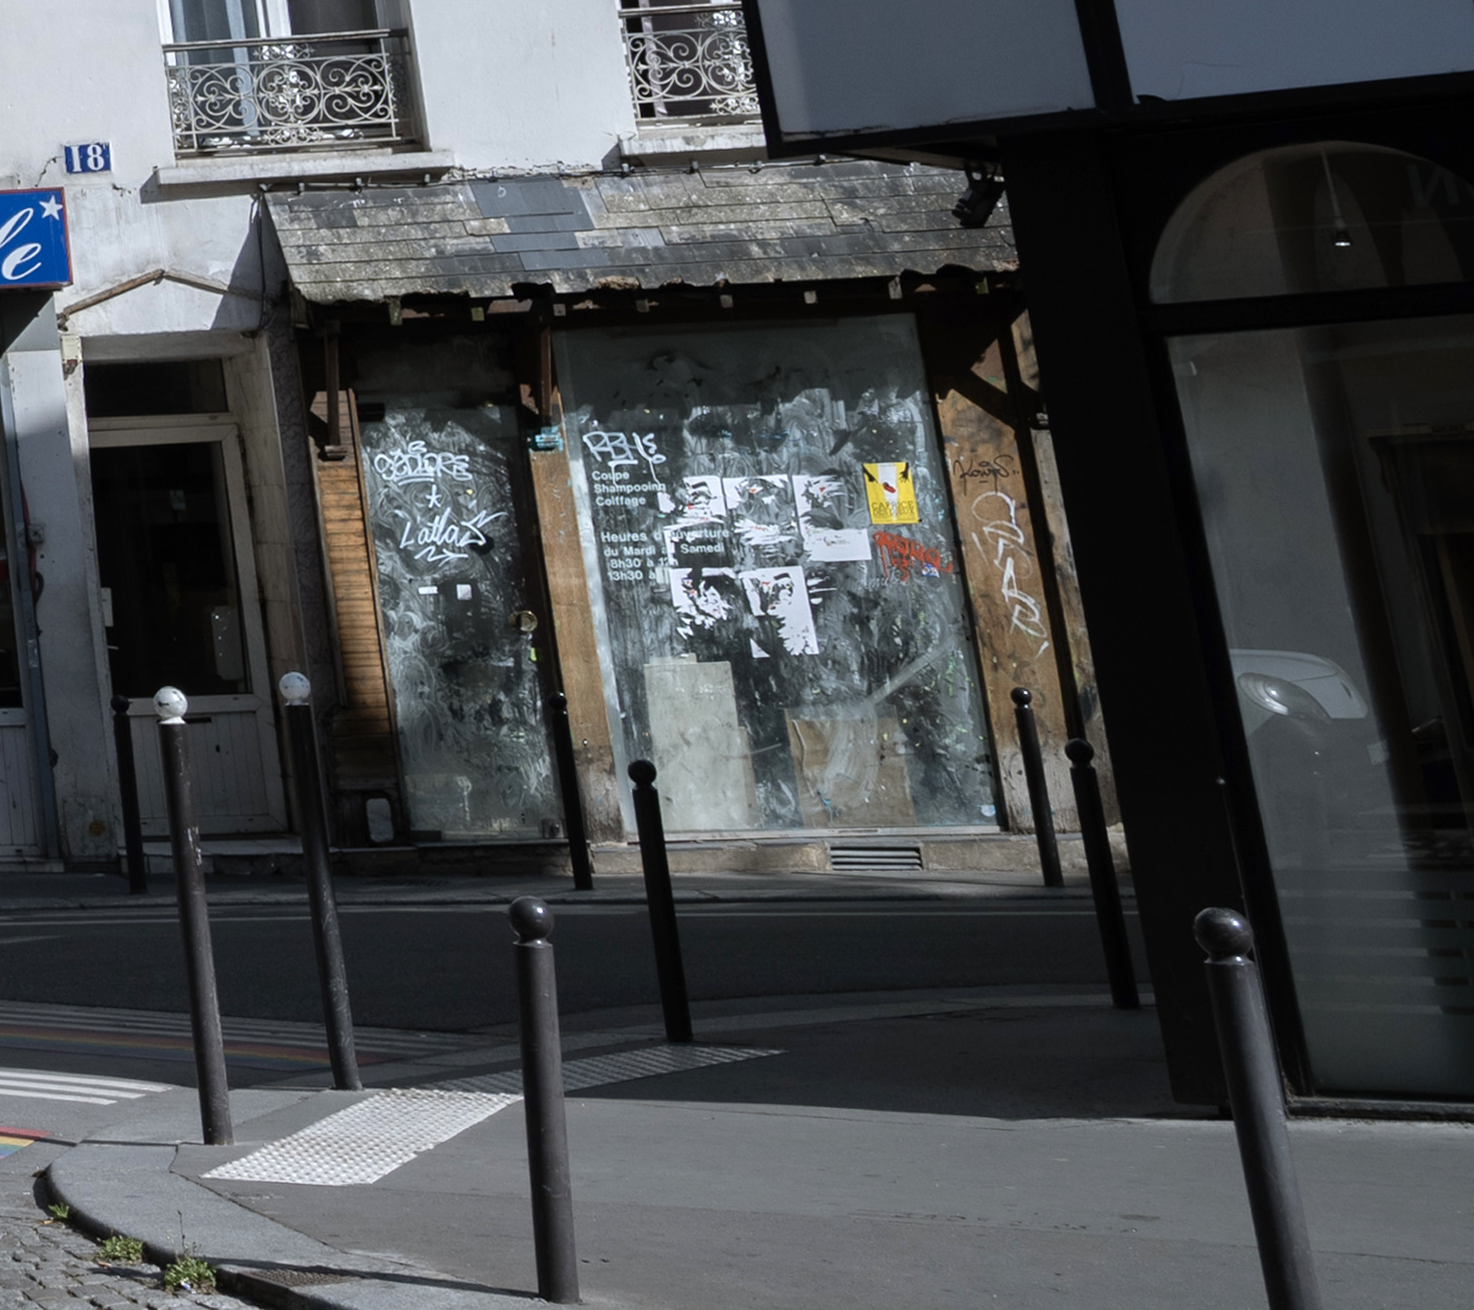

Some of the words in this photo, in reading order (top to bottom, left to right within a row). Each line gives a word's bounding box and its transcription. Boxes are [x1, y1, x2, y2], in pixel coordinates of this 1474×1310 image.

[70, 145, 107, 171] 18
[592, 471, 630, 482] Coupe
[594, 482, 666, 494] Shampooing
[595, 496, 646, 508] Coiffage
[601, 531, 647, 542] Heures
[604, 547, 618, 556] du
[623, 545, 656, 556] Mardi
[680, 543, 725, 554] Samedi
[610, 558, 641, 568] 8h30
[607, 570, 643, 581] 13h30
